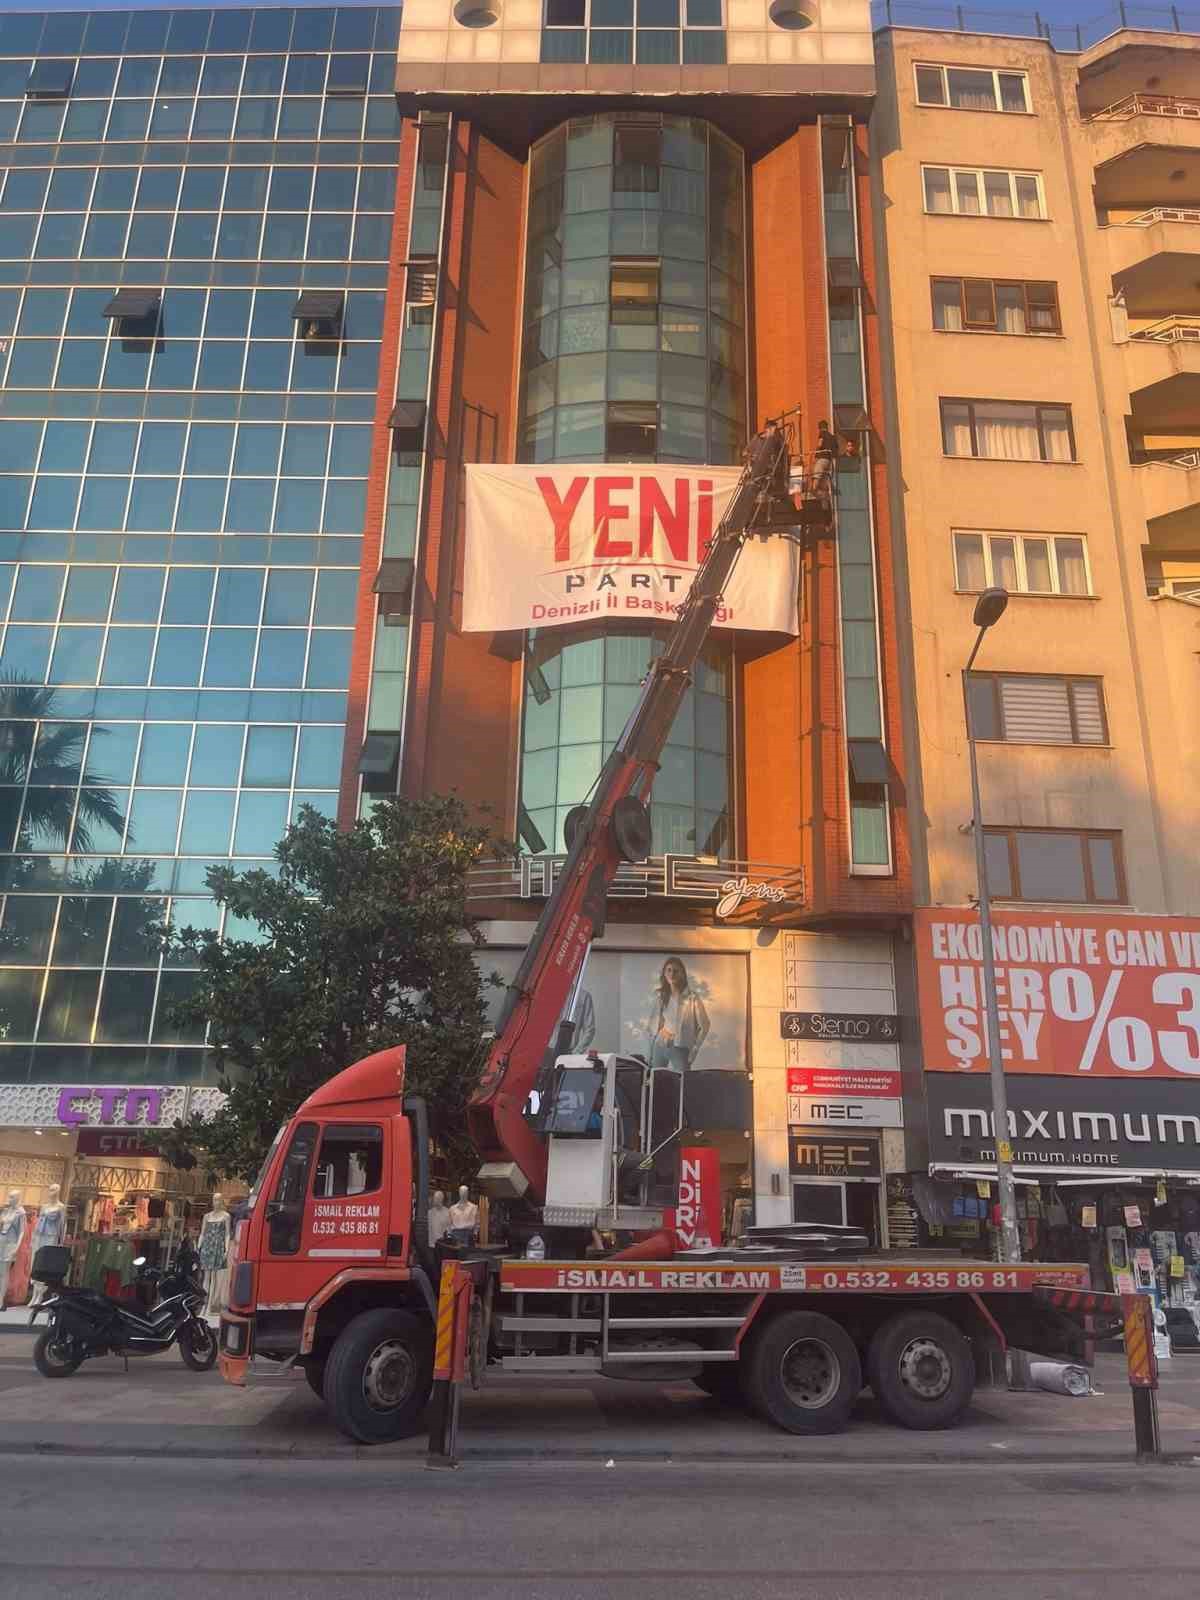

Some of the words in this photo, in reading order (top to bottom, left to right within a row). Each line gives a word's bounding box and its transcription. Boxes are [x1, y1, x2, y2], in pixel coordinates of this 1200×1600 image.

[531, 601, 600, 620] Denizli
[930, 921, 1101, 965] EKONOMİYE
[1105, 928, 1168, 967] CAN
[345, 1205, 380, 1217] REKLAM
[312, 1221, 336, 1234] 0.532
[339, 1221, 355, 1234] 435
[356, 1221, 367, 1234] 86
[368, 1221, 379, 1234] 81
[660, 1271, 770, 1289] REKLAM
[905, 1271, 949, 1288] 435
[957, 1271, 985, 1288] 86
[992, 1271, 1019, 1288] 81
